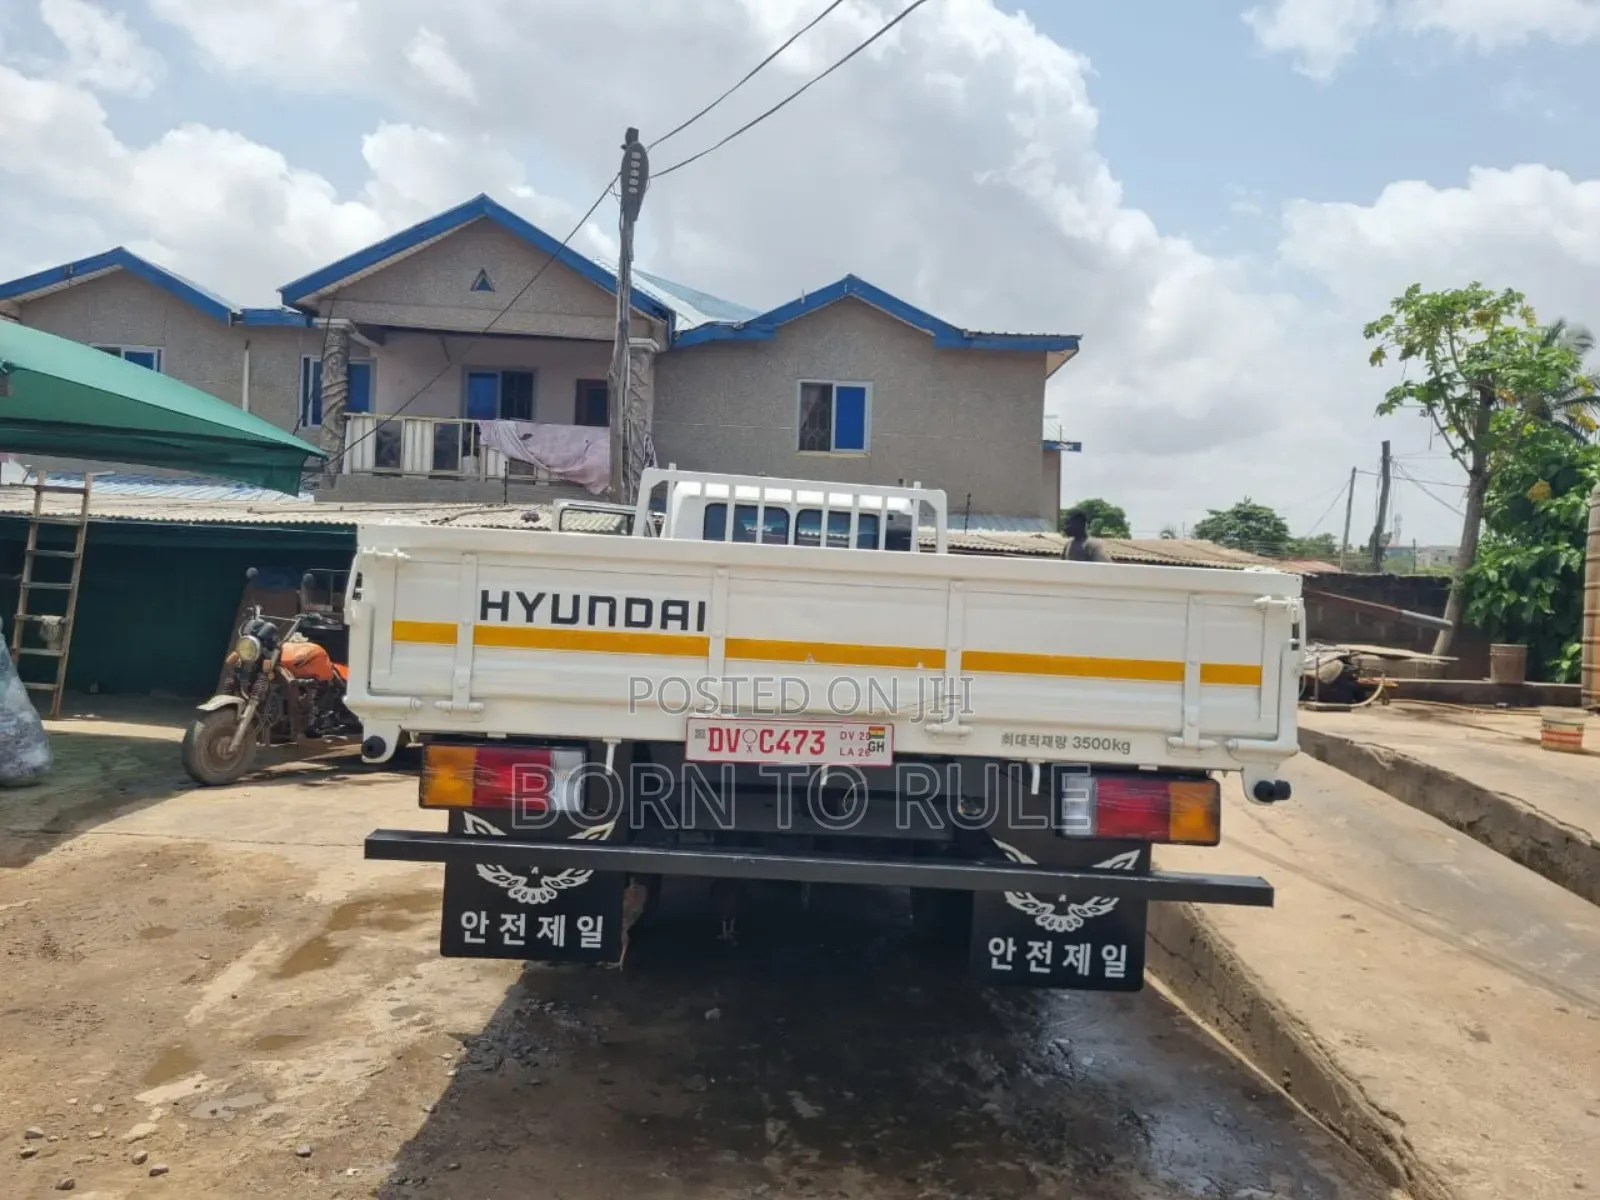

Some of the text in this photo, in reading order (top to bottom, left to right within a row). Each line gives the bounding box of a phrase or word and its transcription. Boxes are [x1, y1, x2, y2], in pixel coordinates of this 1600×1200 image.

[479, 589, 706, 632] HYUNDAI
[758, 728, 826, 756] C473
[839, 730, 855, 741] DV
[868, 740, 885, 753] GH
[1072, 735, 1131, 755] 3500kg
[460, 910, 604, 949] 안전제일
[988, 936, 1128, 979] 안전제일
